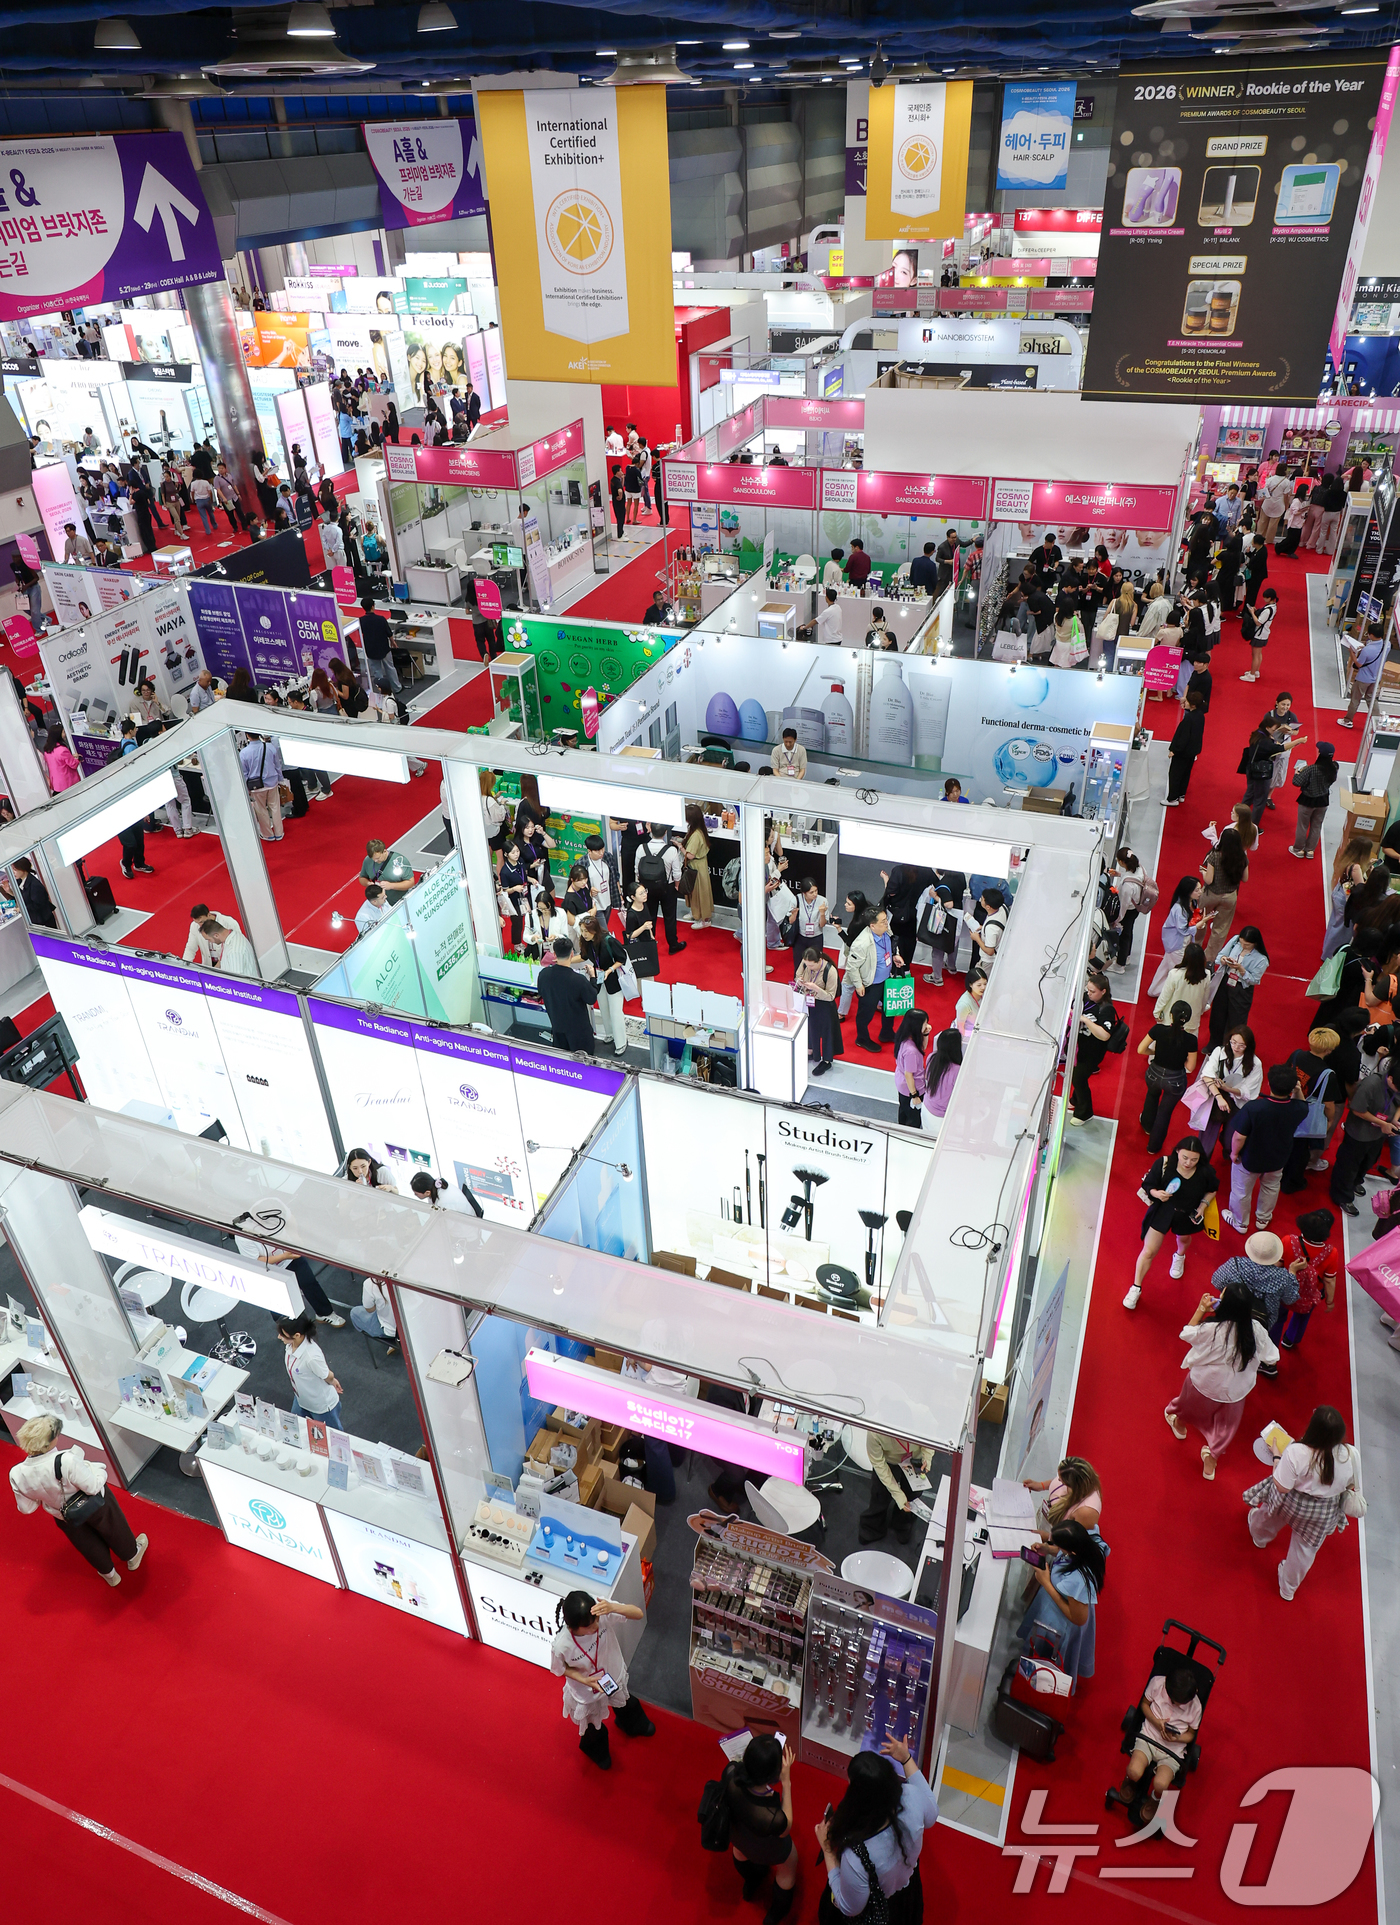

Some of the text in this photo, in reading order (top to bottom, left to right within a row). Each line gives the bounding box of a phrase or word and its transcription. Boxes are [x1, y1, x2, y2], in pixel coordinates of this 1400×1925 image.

[1134, 79, 1365, 100] 2026 WINNER Rookie of the Year
[907, 103, 932, 113] 국제인증
[1242, 108, 1287, 116] COSMOBEAUTY
[908, 113, 931, 123] 전시회+
[537, 118, 608, 132] International
[550, 135, 597, 149] Certified
[1005, 132, 1066, 151] 헤어·두피
[1211, 142, 1263, 151] GRAND PRIZE
[393, 137, 429, 163] A홀 &
[544, 153, 605, 166] Exhibition+
[399, 163, 457, 183] 프리미엄 브릿지존
[10, 168, 42, 208] &
[403, 186, 423, 202] 가는길
[1019, 212, 1033, 221] T37
[40, 209, 108, 239] 브릿지존
[550, 222, 607, 270] ASSOCIATION EXHIBITION
[203, 271, 218, 279] Lobby
[288, 279, 314, 289] Rokkiss
[412, 317, 455, 328] Feelody
[937, 334, 995, 342] NANOBIOSYSTEM
[1145, 359, 1196, 367] Congratulations
[1145, 368, 1198, 376] COSMOBEAUTY
[1198, 368, 1220, 376] SEOUL
[1221, 369, 1251, 377] Premium
[1316, 399, 1375, 409] LALARECIPE
[389, 456, 414, 464] COSMO
[391, 462, 415, 470] BEAUTY
[448, 459, 479, 469] 보타닉센스
[449, 469, 481, 477] BOTANICSENS
[668, 473, 696, 482] COSMO
[668, 480, 696, 488] BEAUTY
[825, 482, 856, 491] COSMO
[732, 487, 777, 497] SANSOOJULONG
[825, 489, 856, 498] BEAUTY
[997, 493, 1030, 501] COSMO
[896, 497, 943, 506] SANSOOJULONG
[997, 500, 1029, 508] BEAUTY
[1065, 494, 1137, 508] 에스알씨컴퍼니(주)
[1092, 508, 1106, 516] SRC
[104, 620, 138, 640] ENERGY THERAPY
[156, 615, 186, 637] WAYA
[297, 620, 319, 631] OEM
[298, 629, 321, 641] ODM
[566, 635, 618, 647] VEGAN HERB
[67, 664, 92, 680] AESTHETIC
[73, 672, 89, 684] BRAND
[981, 717, 1083, 737] Functional derma-cosmetic
[423, 866, 456, 900] ALOE CICA
[424, 886, 460, 923] SUNSCREEN
[439, 943, 469, 978] 4,036,763
[71, 951, 263, 1003] The Radiance Anti-aging Natural Derma Medical Institute
[375, 950, 400, 992] ALOE
[886, 999, 913, 1011] EARTH
[357, 1019, 584, 1080] The Radiance Anti-aging Natural Derma Medical Institute
[778, 1120, 874, 1156] Studio17
[784, 1141, 868, 1165] Makeup Artist Brush Studio17
[136, 1242, 247, 1294] TRANDMI
[626, 1400, 696, 1430] Studio17
[629, 1413, 693, 1441] 스튜디오17
[774, 1441, 800, 1457] T-03
[227, 1510, 325, 1561] TRANDMI
[362, 1525, 415, 1550] TRANDMI
[730, 1525, 809, 1552] Makeup Artist Brush
[724, 1531, 819, 1564] Studio17
[781, 1556, 807, 1568] YOUNG
[702, 1675, 781, 1713] Studio17
